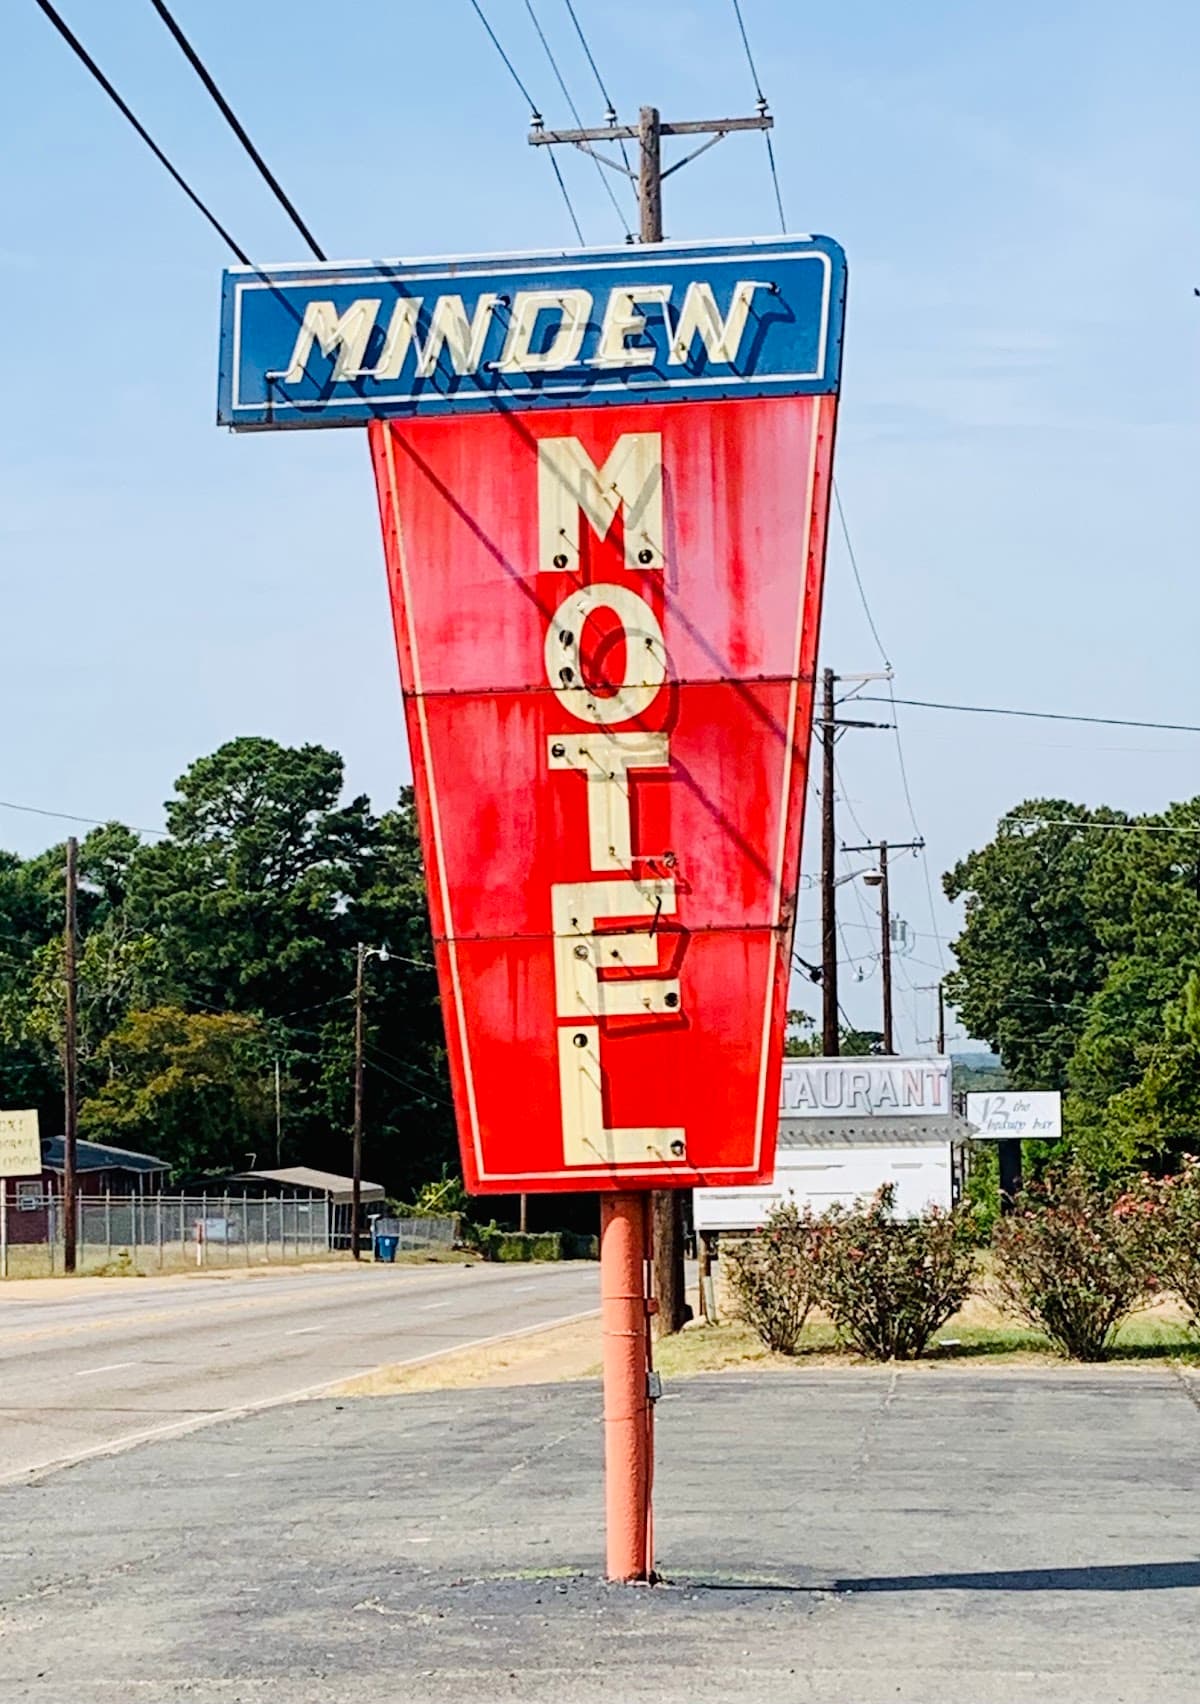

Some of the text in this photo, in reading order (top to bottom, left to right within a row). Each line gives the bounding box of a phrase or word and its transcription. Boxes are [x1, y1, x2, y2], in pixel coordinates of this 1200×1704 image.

[267, 281, 770, 385] MINDEN
[537, 432, 686, 1167] MOTEL
[1013, 1099, 1031, 1112] the
[1032, 1117, 1054, 1130] bar
